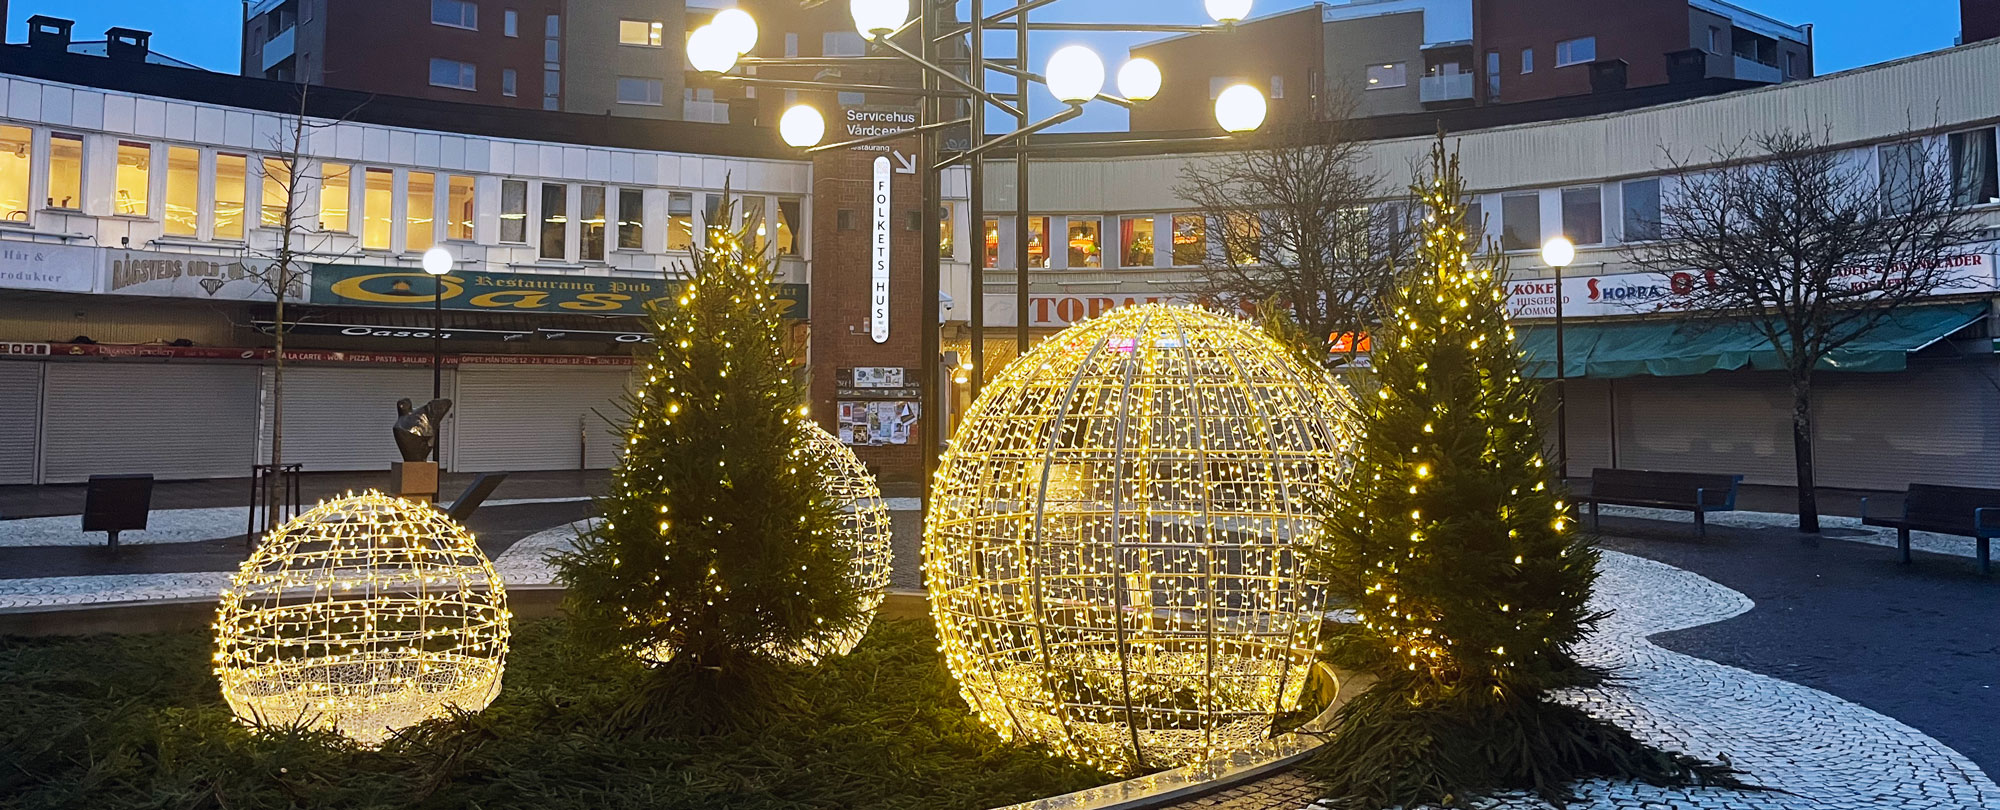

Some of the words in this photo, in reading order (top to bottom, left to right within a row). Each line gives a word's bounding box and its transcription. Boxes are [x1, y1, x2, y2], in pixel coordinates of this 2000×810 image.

[847, 109, 915, 123] Servicehus
[876, 181, 887, 271] FOLKETS
[34, 252, 44, 261] &
[0, 271, 62, 282] rodukter
[112, 253, 182, 291] RÅGSVEDS
[475, 275, 596, 292] Restaurang
[608, 280, 651, 297] Pub
[1587, 278, 1661, 301] SHOPPA
[876, 282, 885, 319] HUS
[1517, 296, 1569, 306] HUSGERD
[1514, 306, 1558, 316] BLOMMO
